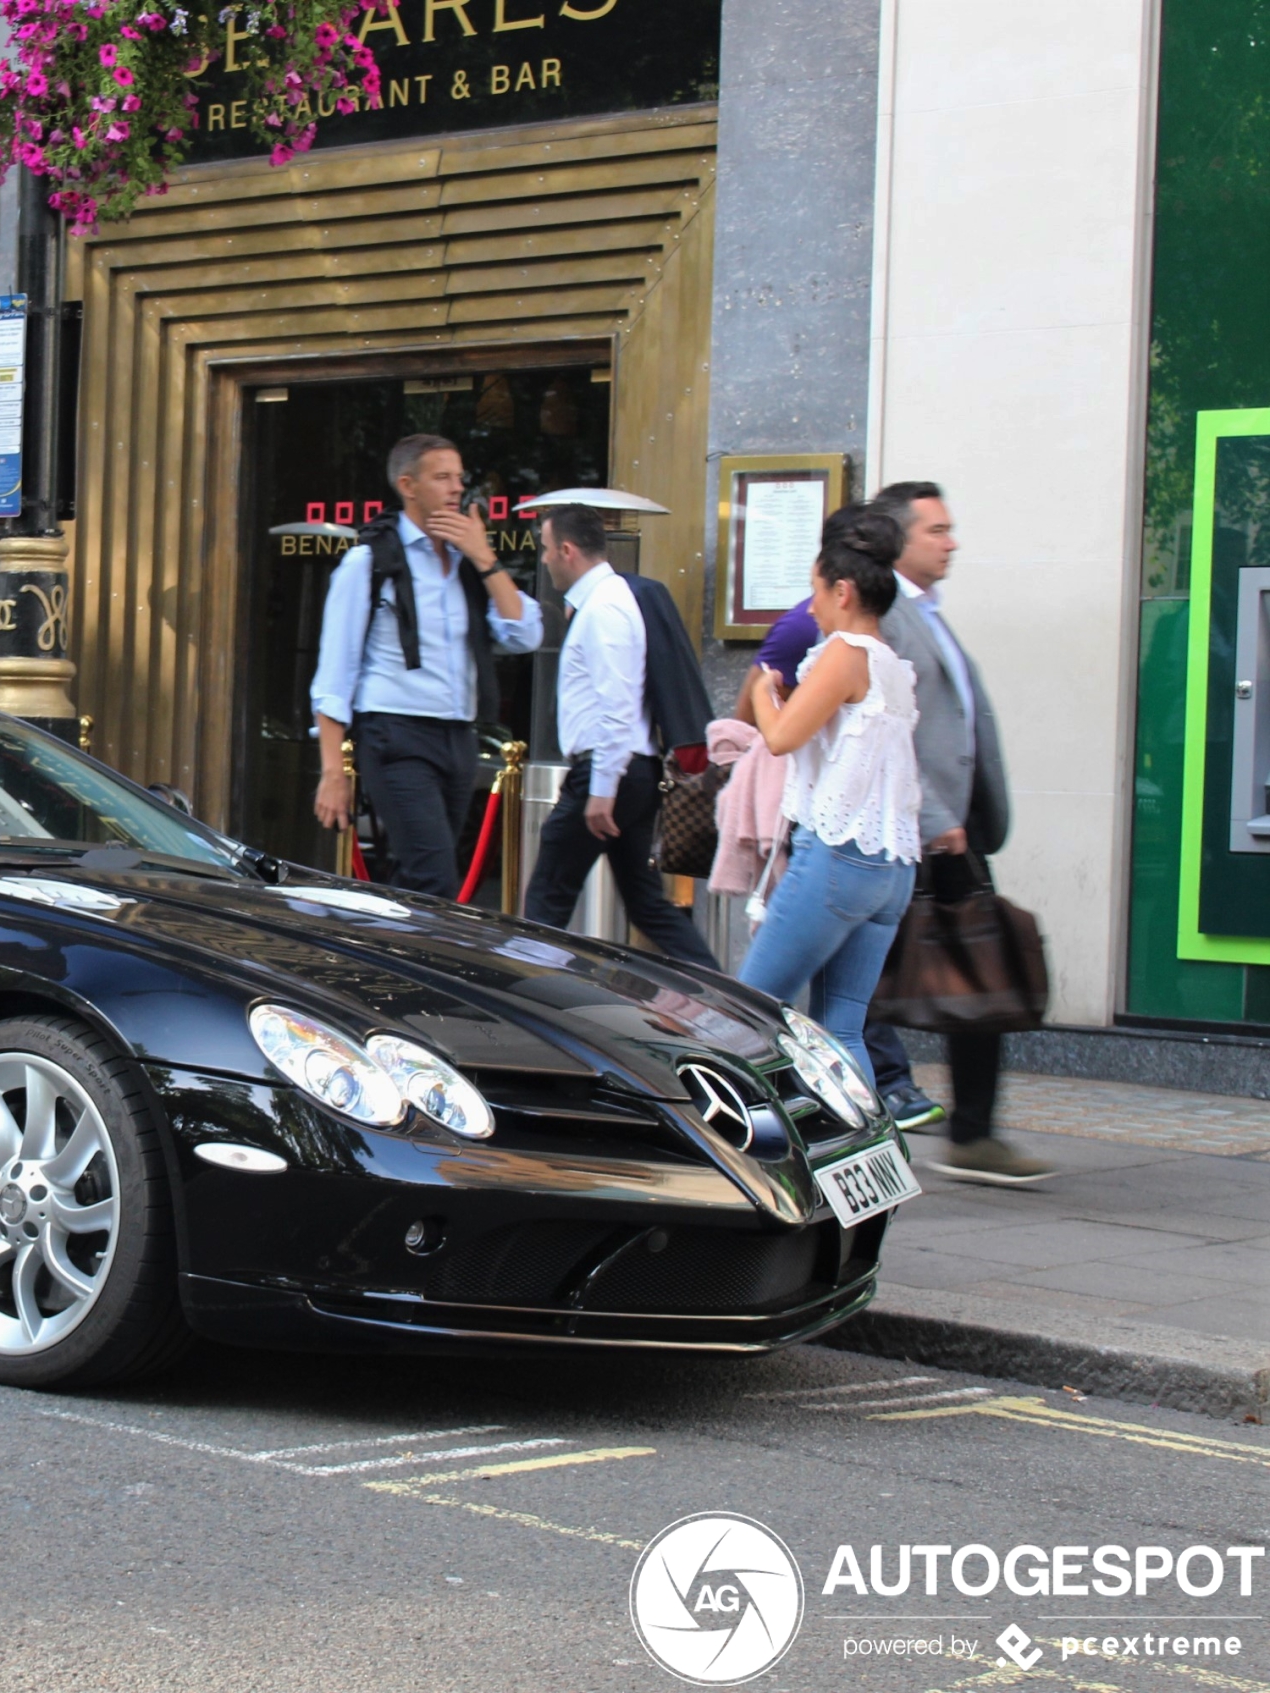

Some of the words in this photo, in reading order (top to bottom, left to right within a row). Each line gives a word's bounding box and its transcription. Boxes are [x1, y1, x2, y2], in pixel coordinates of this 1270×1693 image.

[451, 70, 471, 100] &
[491, 58, 561, 95] BAR
[25, 1028, 52, 1042] Pilot
[54, 1039, 83, 1061] Super
[85, 1063, 111, 1094] Sport
[832, 1164, 879, 1213] B33
[866, 1150, 907, 1199] NNY
